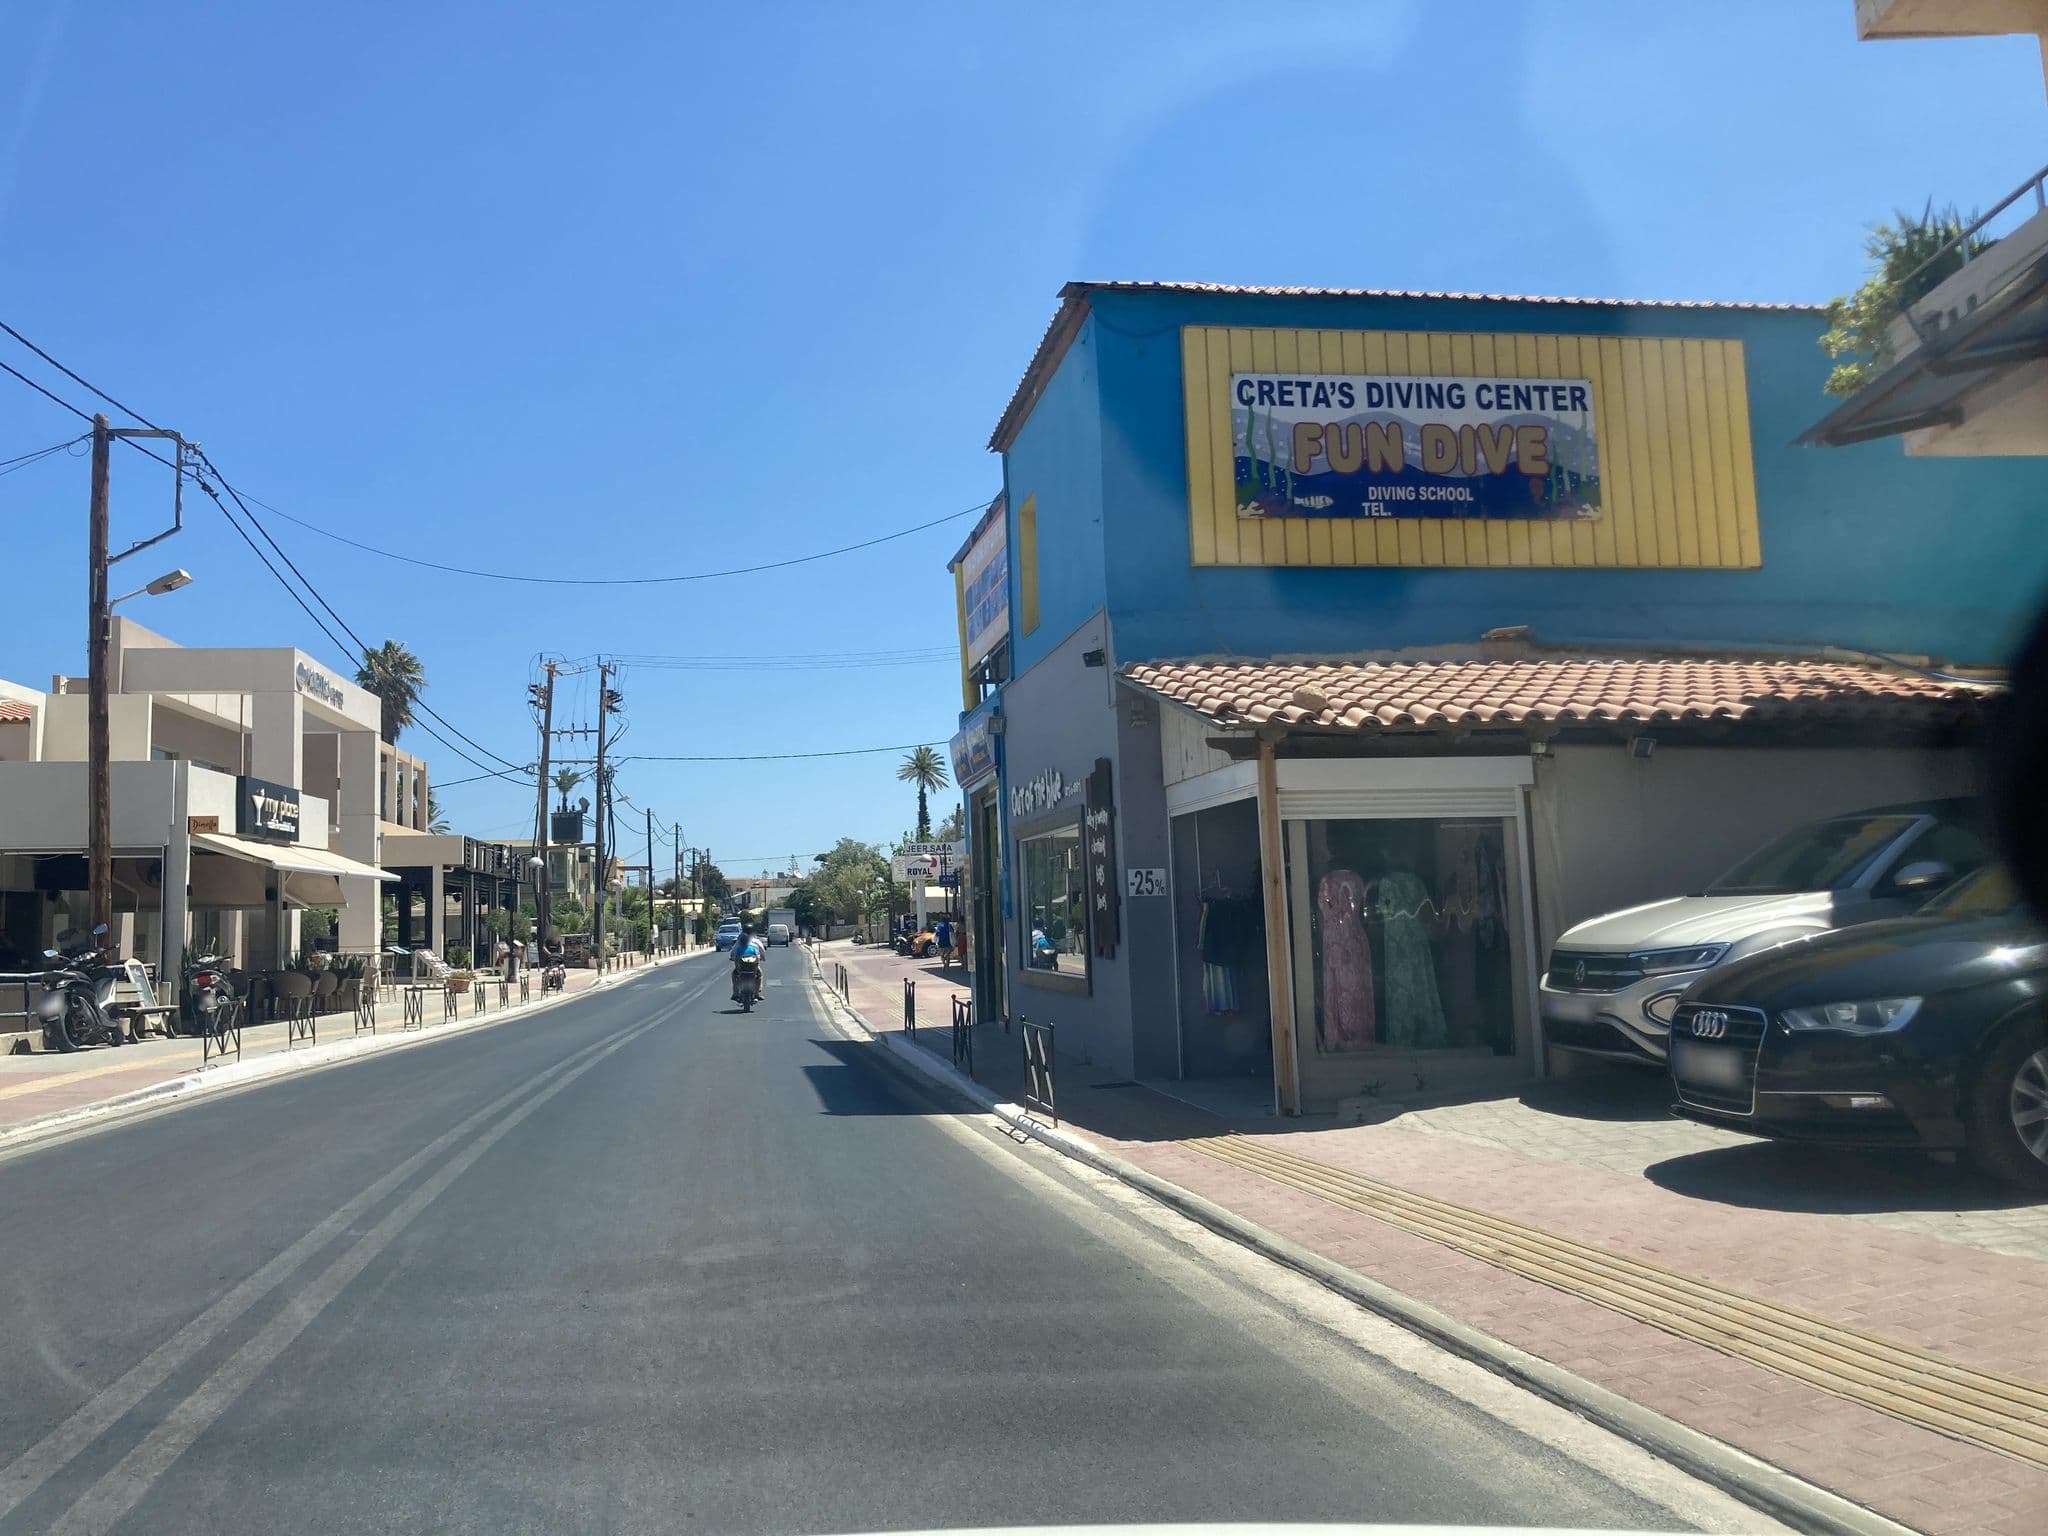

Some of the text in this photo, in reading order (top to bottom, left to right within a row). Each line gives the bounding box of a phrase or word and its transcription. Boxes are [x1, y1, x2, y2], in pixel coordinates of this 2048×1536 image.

[1236, 379, 1588, 412] CRETA'S DIVING CENTER
[1293, 421, 1550, 476] FUN DIVE
[1367, 486, 1474, 501] DIVING SCHOOL
[1361, 502, 1392, 516] TEL.
[265, 795, 299, 821] my place
[907, 867, 933, 876] ROYAL
[1130, 870, 1165, 895] -25%
